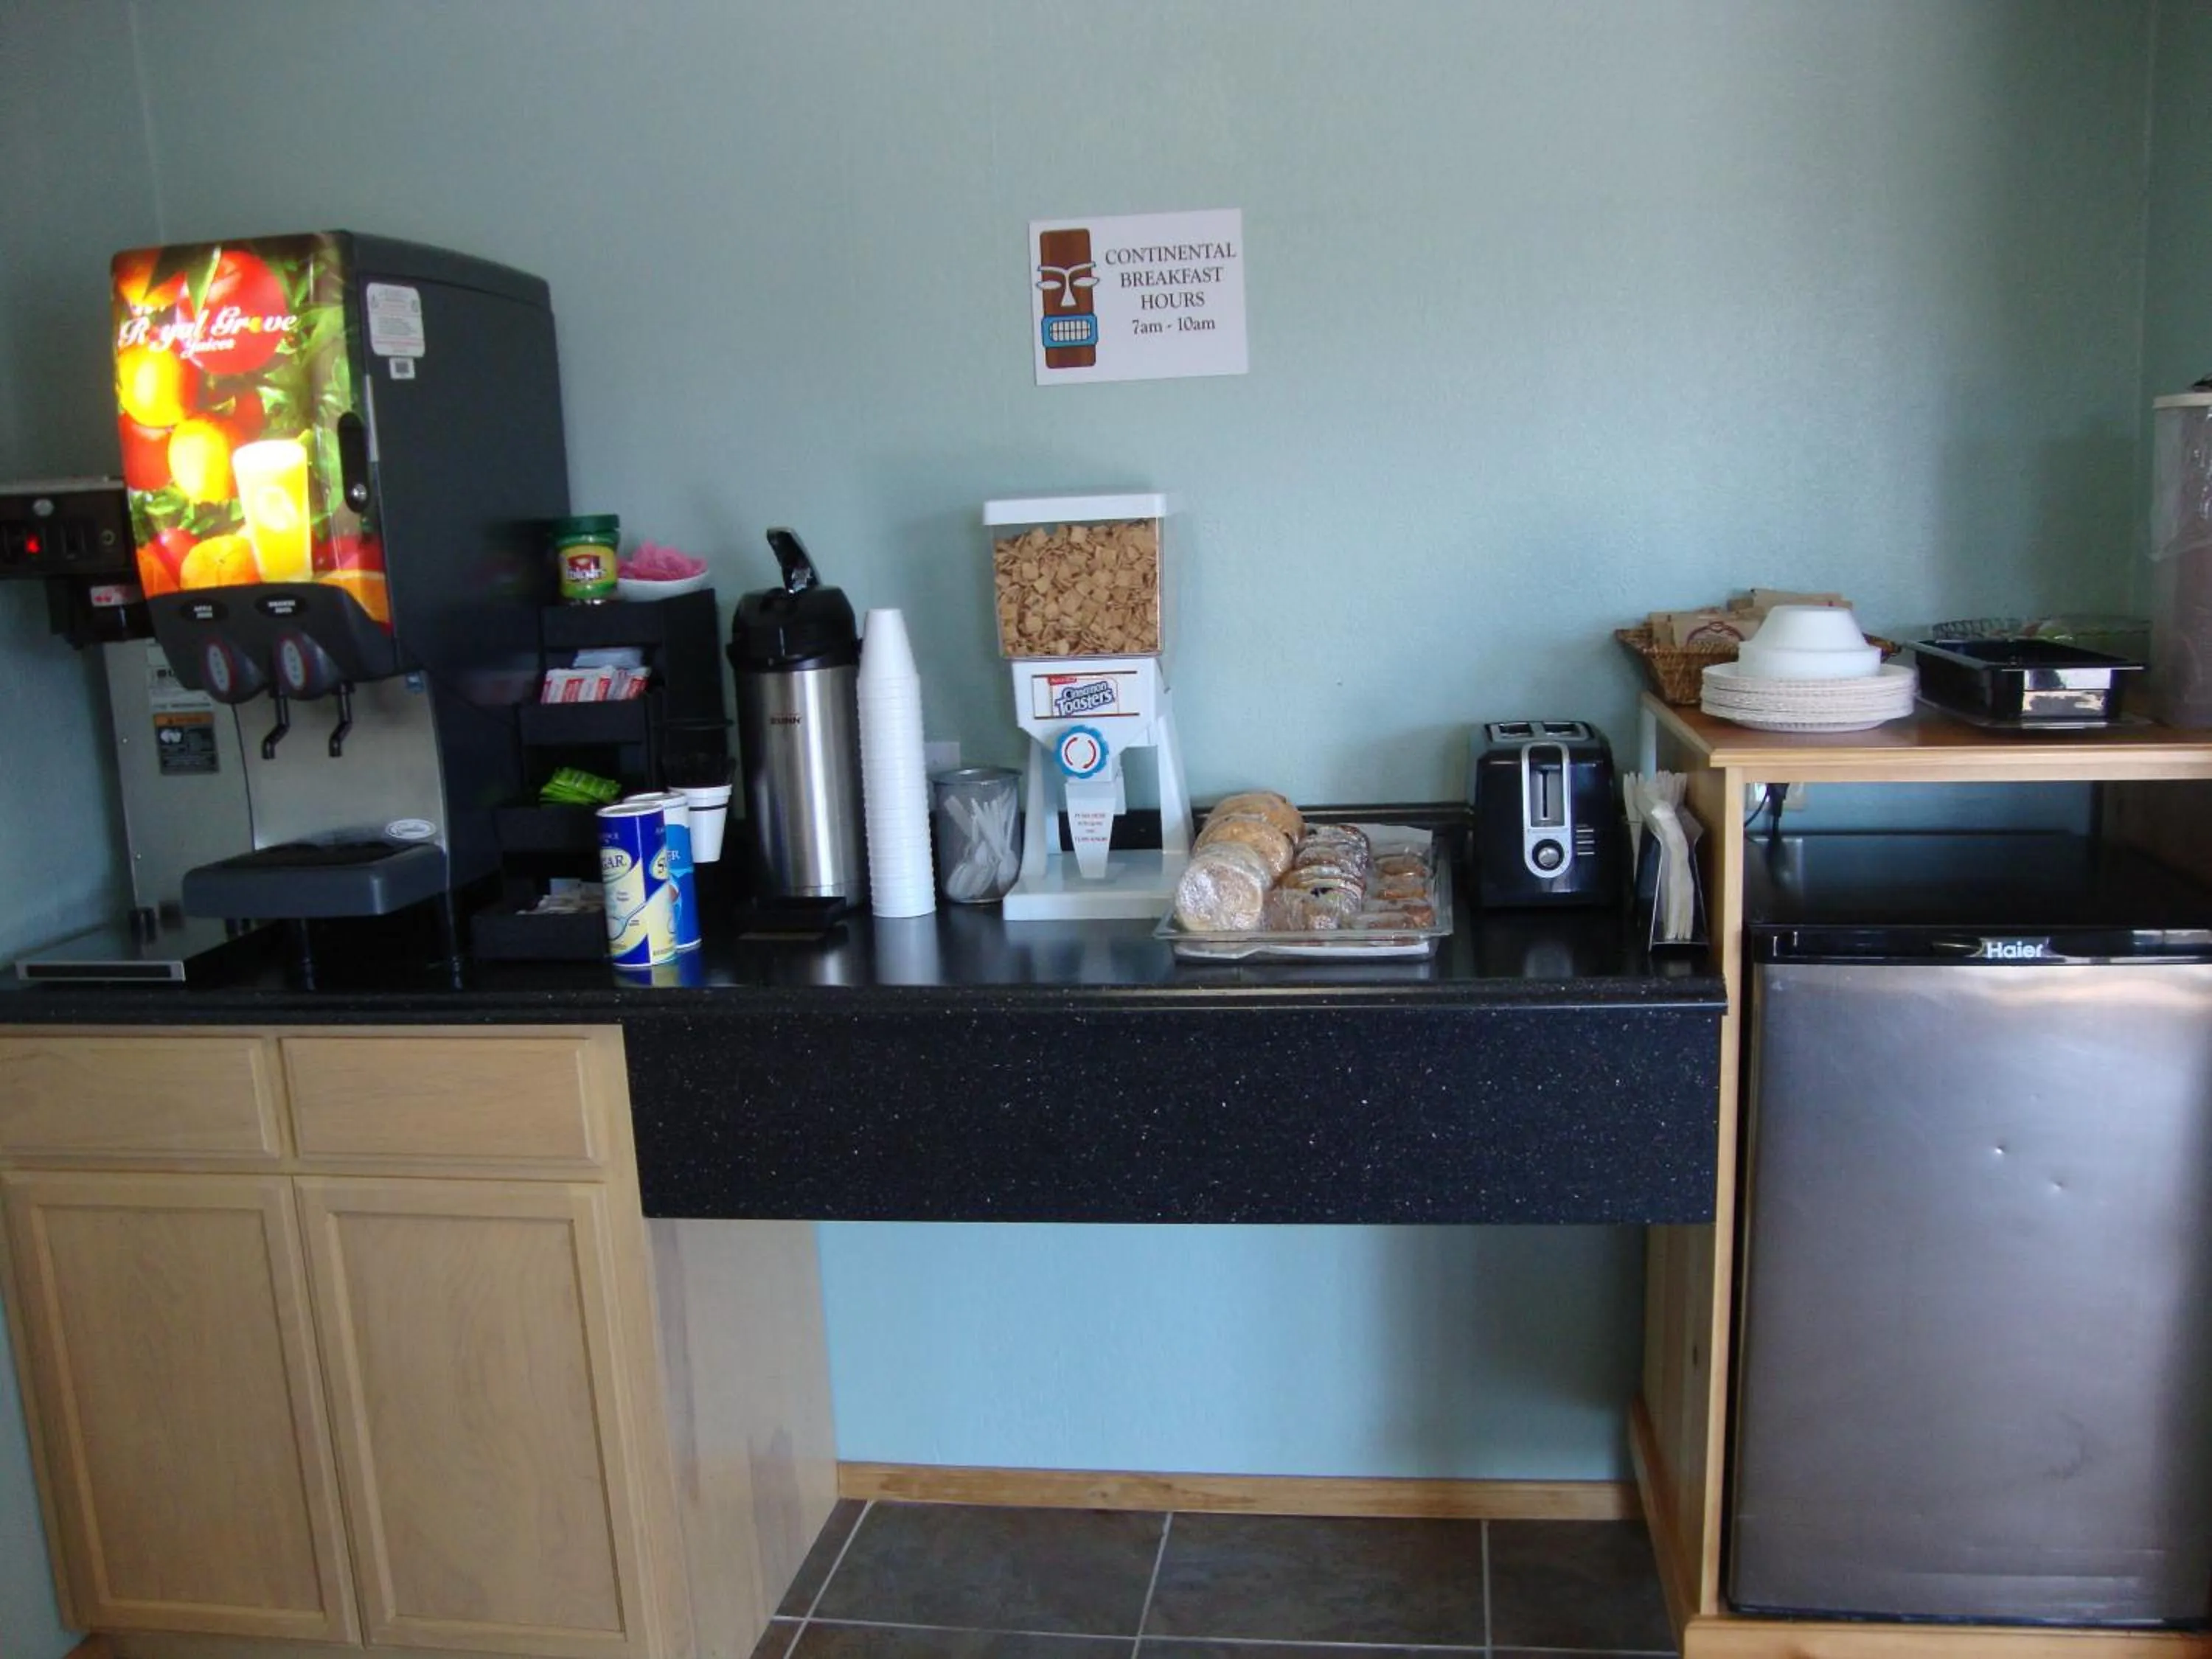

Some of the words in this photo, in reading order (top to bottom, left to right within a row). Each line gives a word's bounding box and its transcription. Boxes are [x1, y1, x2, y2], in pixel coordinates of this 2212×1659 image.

[1105, 241, 1237, 265] CONTINENTAL
[1120, 266, 1224, 288] BREAKFAST
[1140, 291, 1206, 310] HOURS
[1132, 319, 1163, 335] 7am
[1178, 316, 1216, 332] 10am
[1057, 691, 1113, 714] Toasters
[1986, 941, 2044, 959] Haier
